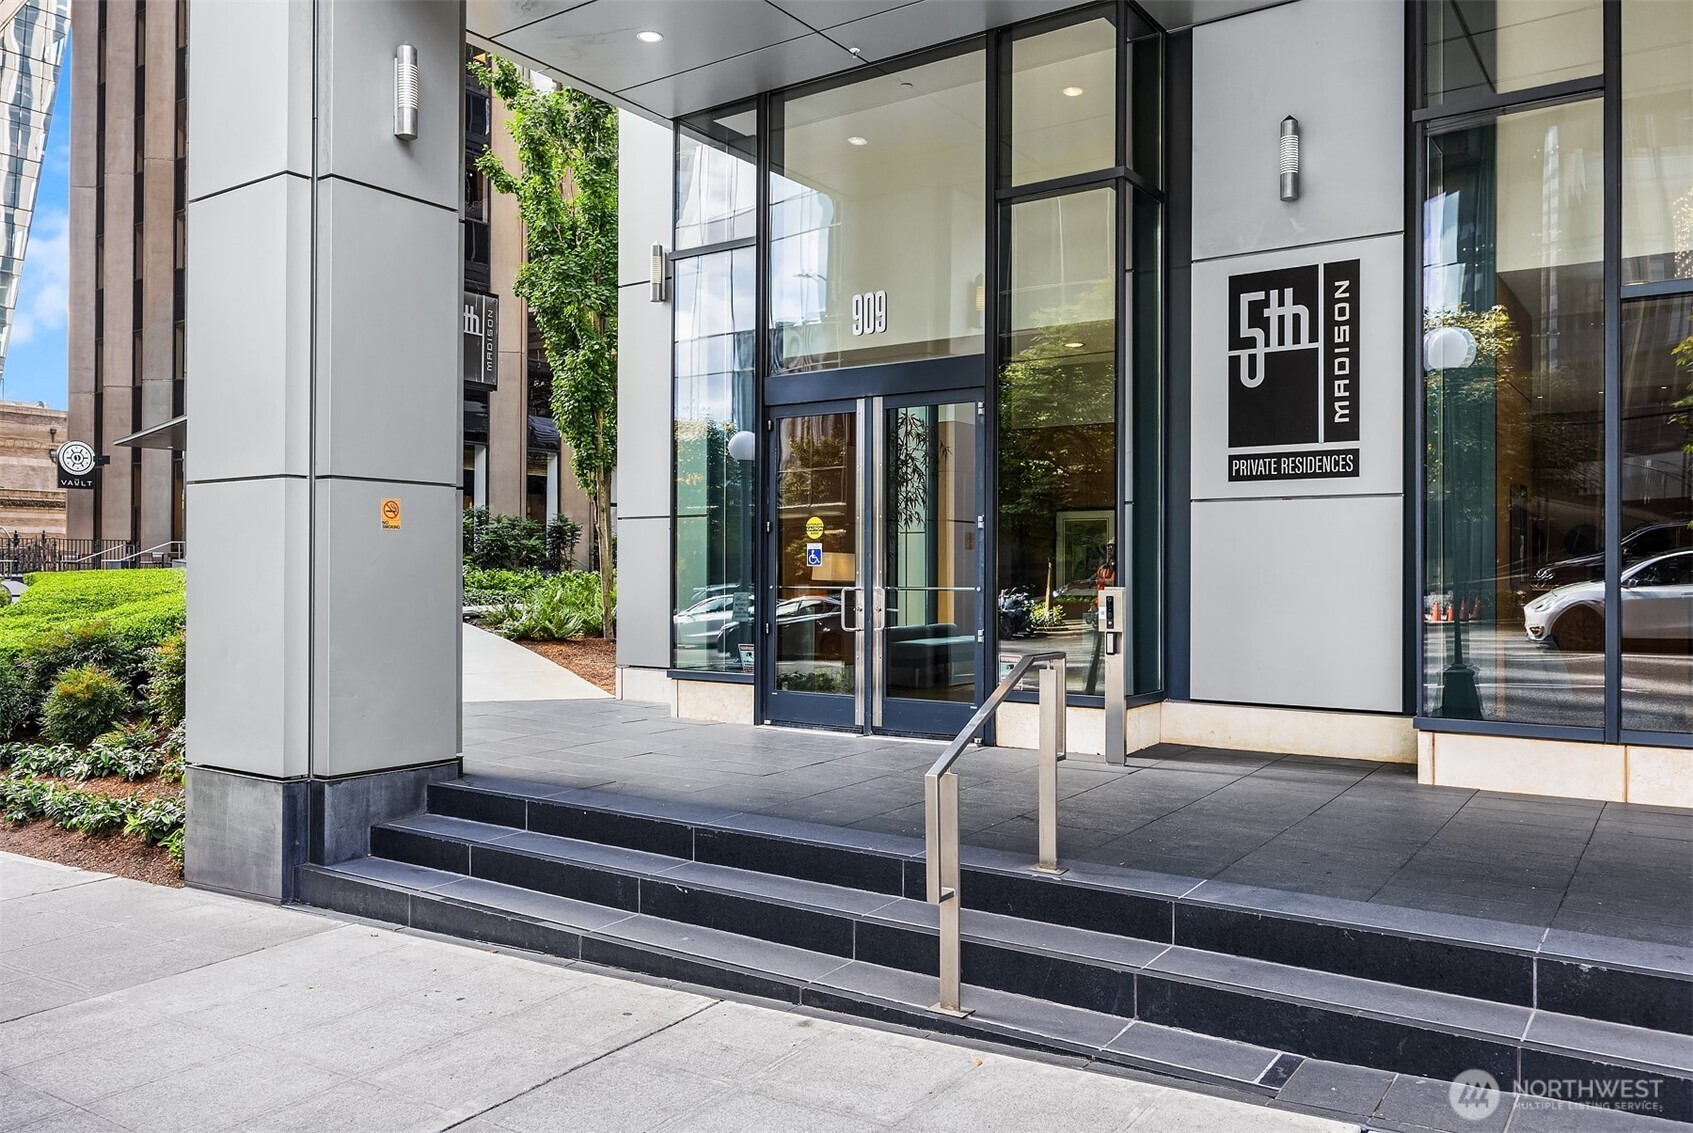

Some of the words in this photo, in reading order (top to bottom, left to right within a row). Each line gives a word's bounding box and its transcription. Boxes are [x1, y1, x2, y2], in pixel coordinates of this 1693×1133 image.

[464, 304, 479, 334] th
[852, 290, 887, 336] 909
[1240, 287, 1309, 388] 5th
[1334, 280, 1350, 423] MADISON
[61, 479, 93, 487] VAULT
[1232, 458, 1278, 476] PRIVATE
[1281, 454, 1354, 474] RESIDENCES
